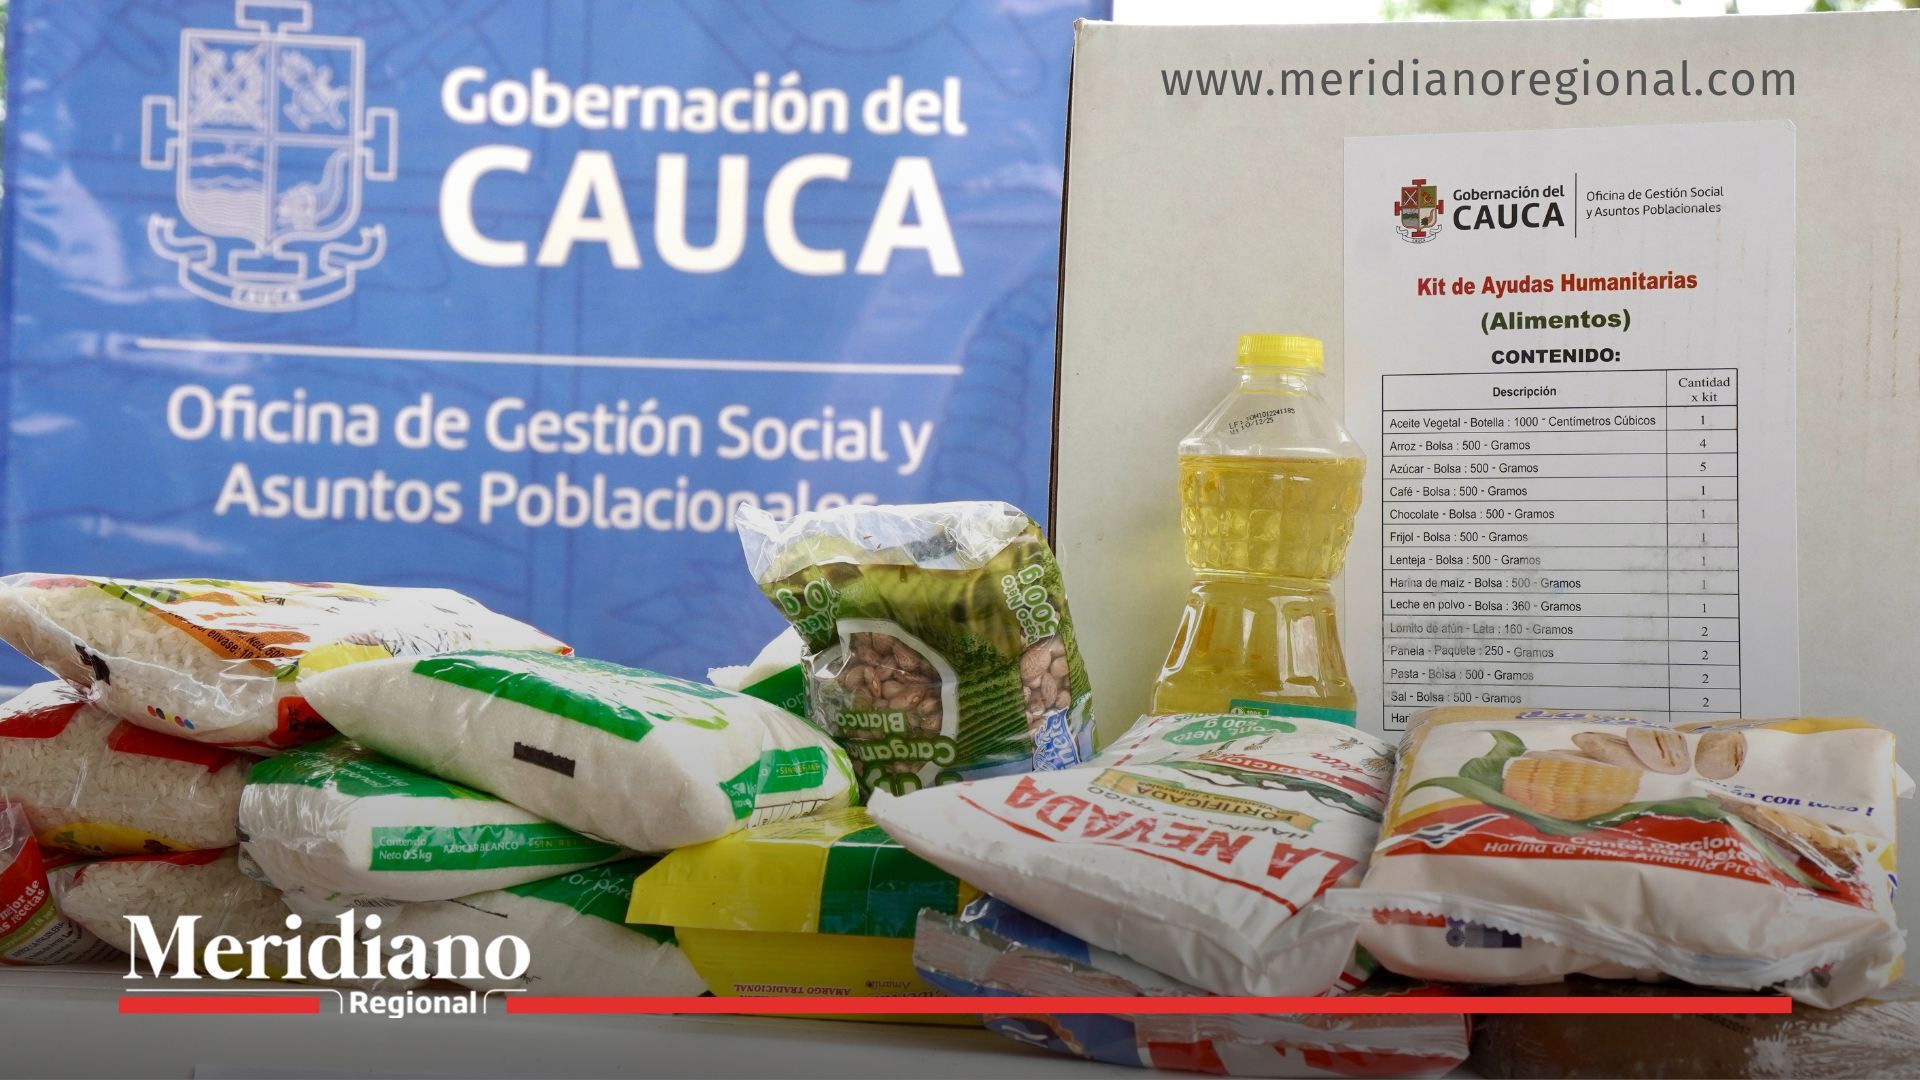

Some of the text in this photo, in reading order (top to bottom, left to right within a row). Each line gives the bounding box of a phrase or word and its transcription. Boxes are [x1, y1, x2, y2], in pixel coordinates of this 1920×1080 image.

[440, 66, 968, 137] Gobernación del
[1453, 185, 1565, 201] Gobernación del
[1586, 186, 1724, 202] Oficina de Gestión Social
[439, 144, 964, 277] CAUCA
[1453, 202, 1565, 230] CAUCA
[1586, 203, 1721, 220] y Asuntos Poblacionales
[1417, 271, 1698, 298] Kit de Ayudas Humanitarias
[1480, 308, 1631, 335] (Alimentos)
[1491, 348, 1621, 365] CONTENIDO:
[1678, 376, 1731, 389] Cantidad
[1493, 385, 1557, 399] Descripción
[1691, 391, 1717, 402] x kit
[1389, 413, 1656, 431] Aceite Vegetal Botella 1000 Centímetros Cúbicos
[1699, 414, 1707, 426] 1
[166, 385, 933, 474] Oficina de Gestión Social y
[1389, 438, 1531, 451] Arroz Bolsa 500 Gramos
[1698, 437, 1708, 449] 4
[1389, 461, 1538, 474] Azúcar Bolsa 500 Gramos
[1699, 461, 1708, 473] 5
[214, 462, 461, 523] Asuntos
[1389, 484, 1528, 497] Café Bolsa 500 Gramos
[1700, 484, 1707, 496] 1
[1389, 507, 1555, 520] Chocolate Bolsa 500 Gramos
[1700, 508, 1707, 520] 1
[1389, 530, 1528, 543] Frijol Bolsa 500 Gramos
[1700, 531, 1708, 543] 1
[1389, 553, 1541, 568] Lenteja Bolsa 500 Gramos
[1700, 555, 1708, 567] 1
[1389, 576, 1581, 589] Harina de maíz Bolsa 500 Gramos
[1700, 579, 1708, 591] 1
[1389, 598, 1582, 613] Leche en polvo Bolsa 360 Gramos
[1701, 602, 1708, 614] 1
[1425, 622, 1438, 634] de
[1472, 622, 1495, 635] Lata
[1504, 623, 1522, 635] 160
[1532, 623, 1573, 635] Gramos
[1700, 626, 1709, 637] 2
[1483, 645, 1503, 657] 250
[1513, 646, 1554, 658] Gramos
[1701, 649, 1709, 661] 2
[1389, 667, 1533, 681] Pasta Bolsa 500 Gramos
[1701, 673, 1710, 684] 2
[1390, 690, 1522, 704] Sal Bolsa 500 Gramos
[1701, 696, 1710, 708] 2
[836, 711, 905, 734] Blanco
[1391, 713, 1411, 723] Har
[1137, 785, 1293, 822] FORTIFICADA
[1761, 794, 1801, 806] con
[1004, 775, 1254, 864] NEVADA
[1484, 841, 1547, 855] Harina
[1553, 842, 1577, 855] de
[378, 850, 402, 860] Neto
[1266, 842, 1360, 900] LA
[733, 983, 852, 996] AMARGO TRADICIONAL
